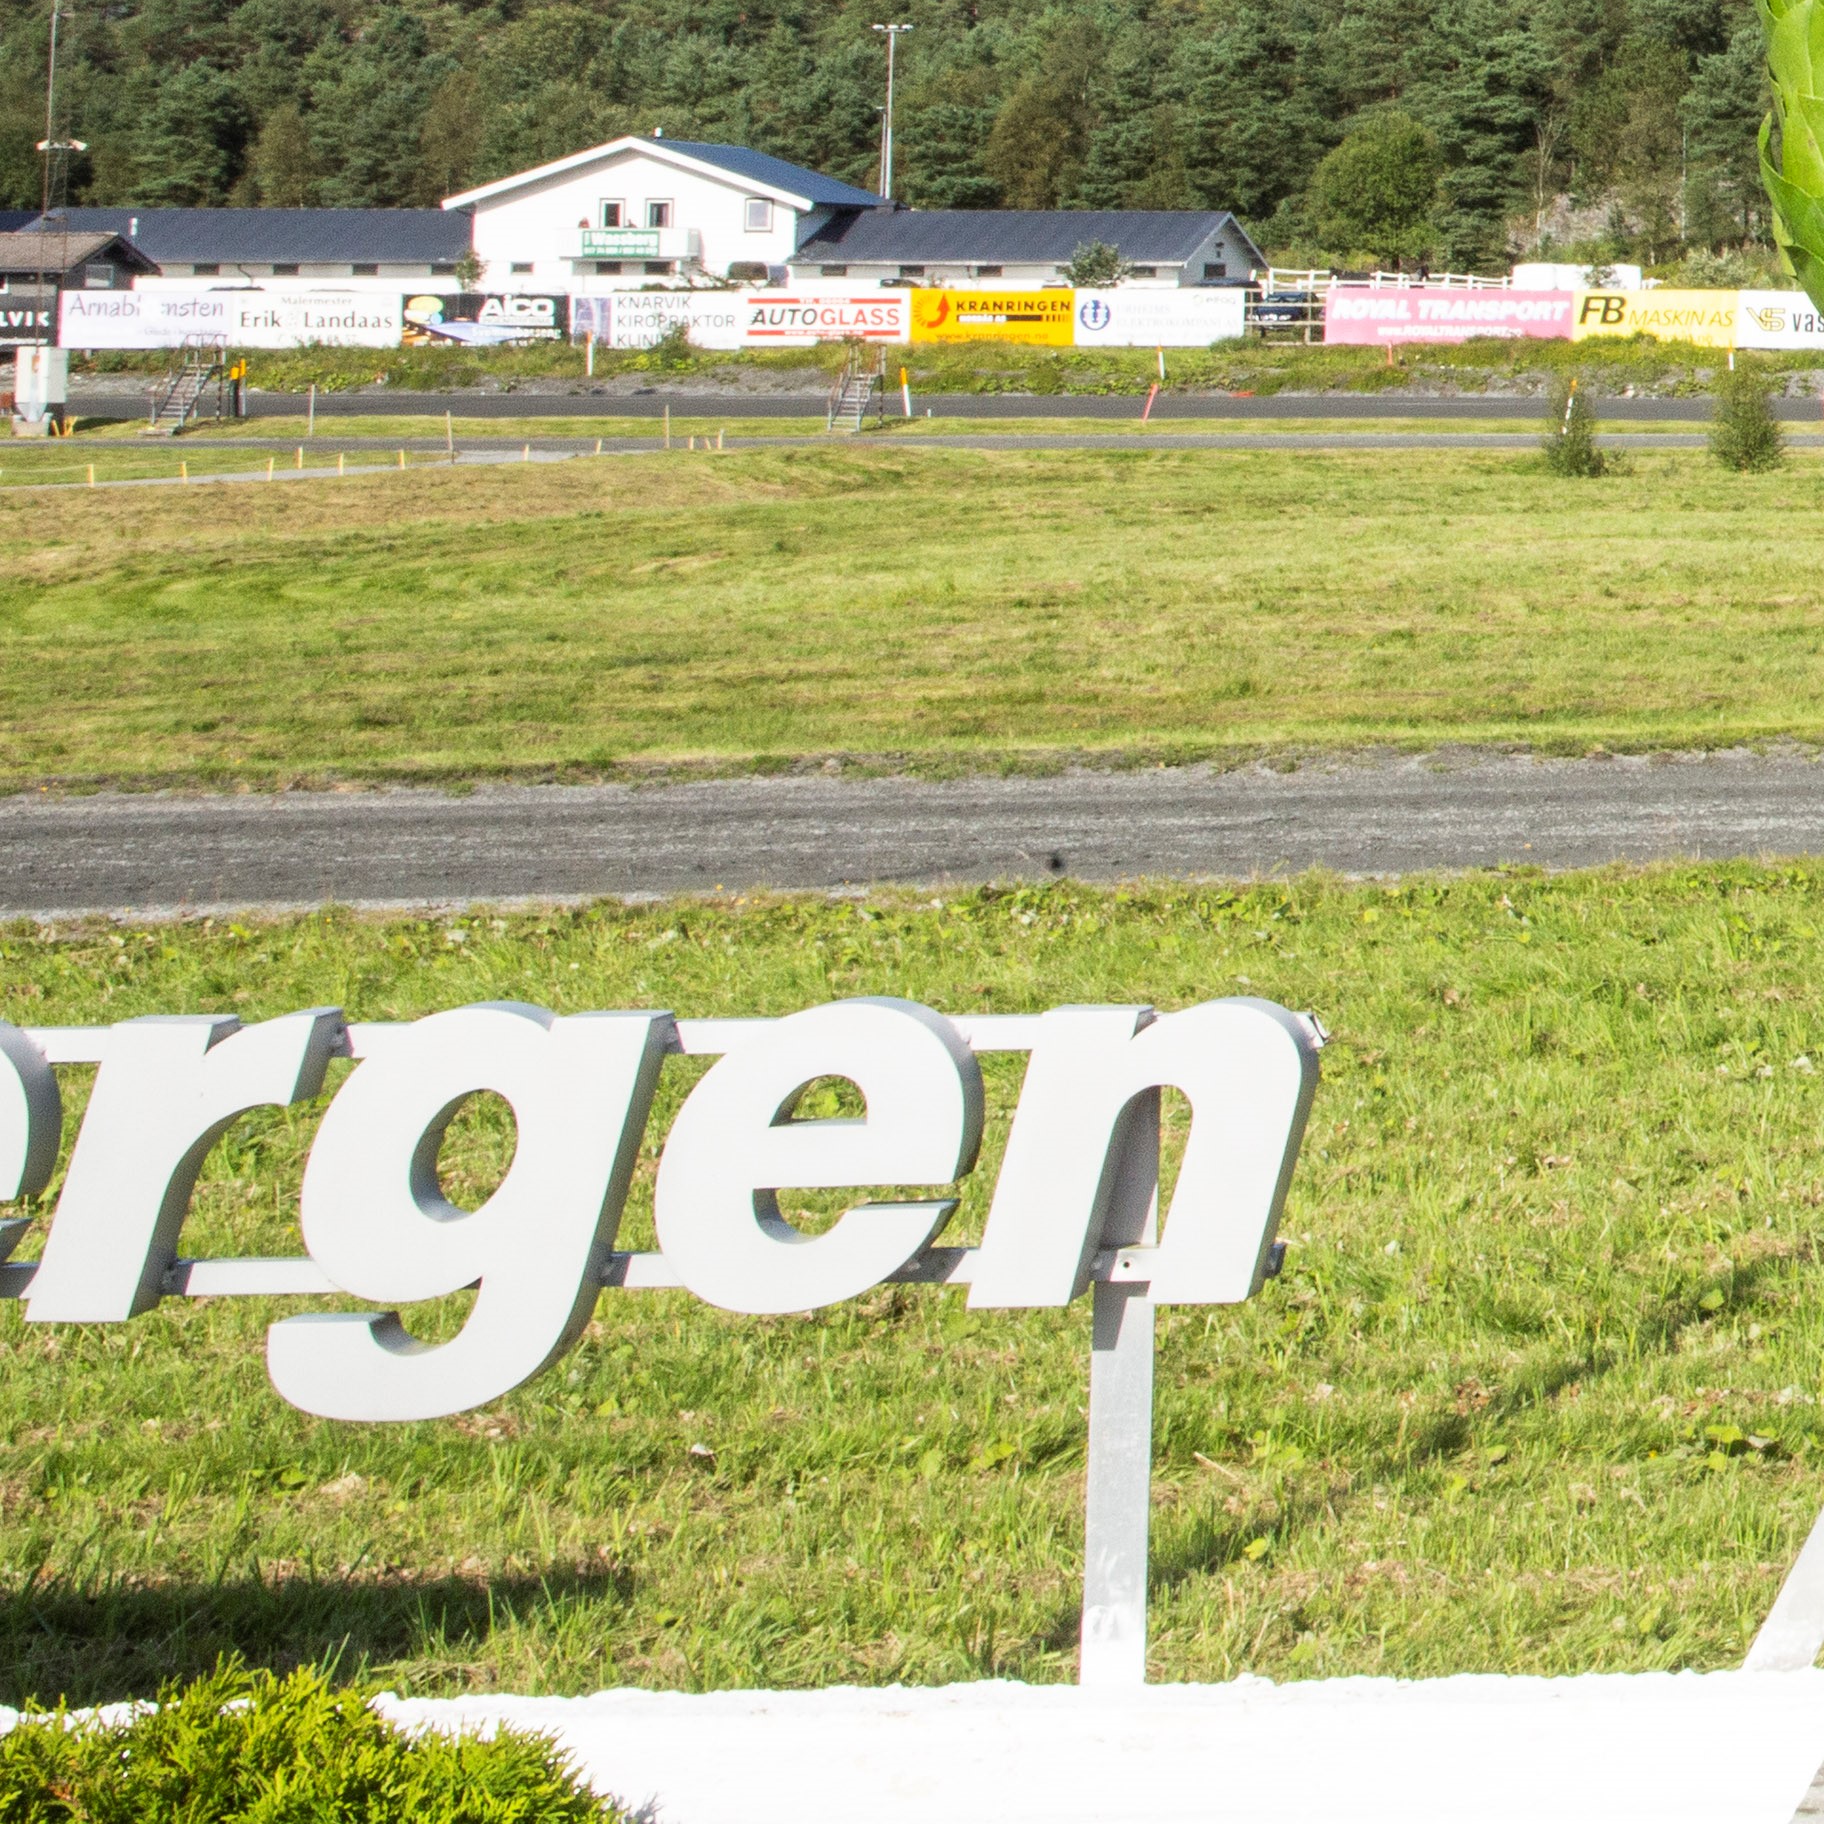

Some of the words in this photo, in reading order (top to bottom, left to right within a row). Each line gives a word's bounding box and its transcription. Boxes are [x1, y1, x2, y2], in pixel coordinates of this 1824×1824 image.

[617, 296, 691, 309] KNARVIK
[956, 301, 1071, 312] KRANRINGEN
[1332, 298, 1411, 321] ROYAL
[1417, 299, 1571, 322] TRANSPORT
[1579, 295, 1627, 325] FB
[1628, 309, 1705, 327] MASKIN
[1709, 309, 1735, 327] AS
[240, 310, 282, 328] Erik
[304, 310, 393, 328] Landaas
[617, 314, 736, 328] KIROPRAKTOR
[751, 308, 900, 326] AUTOGLASS
[0, 996, 1321, 1424] rgen
